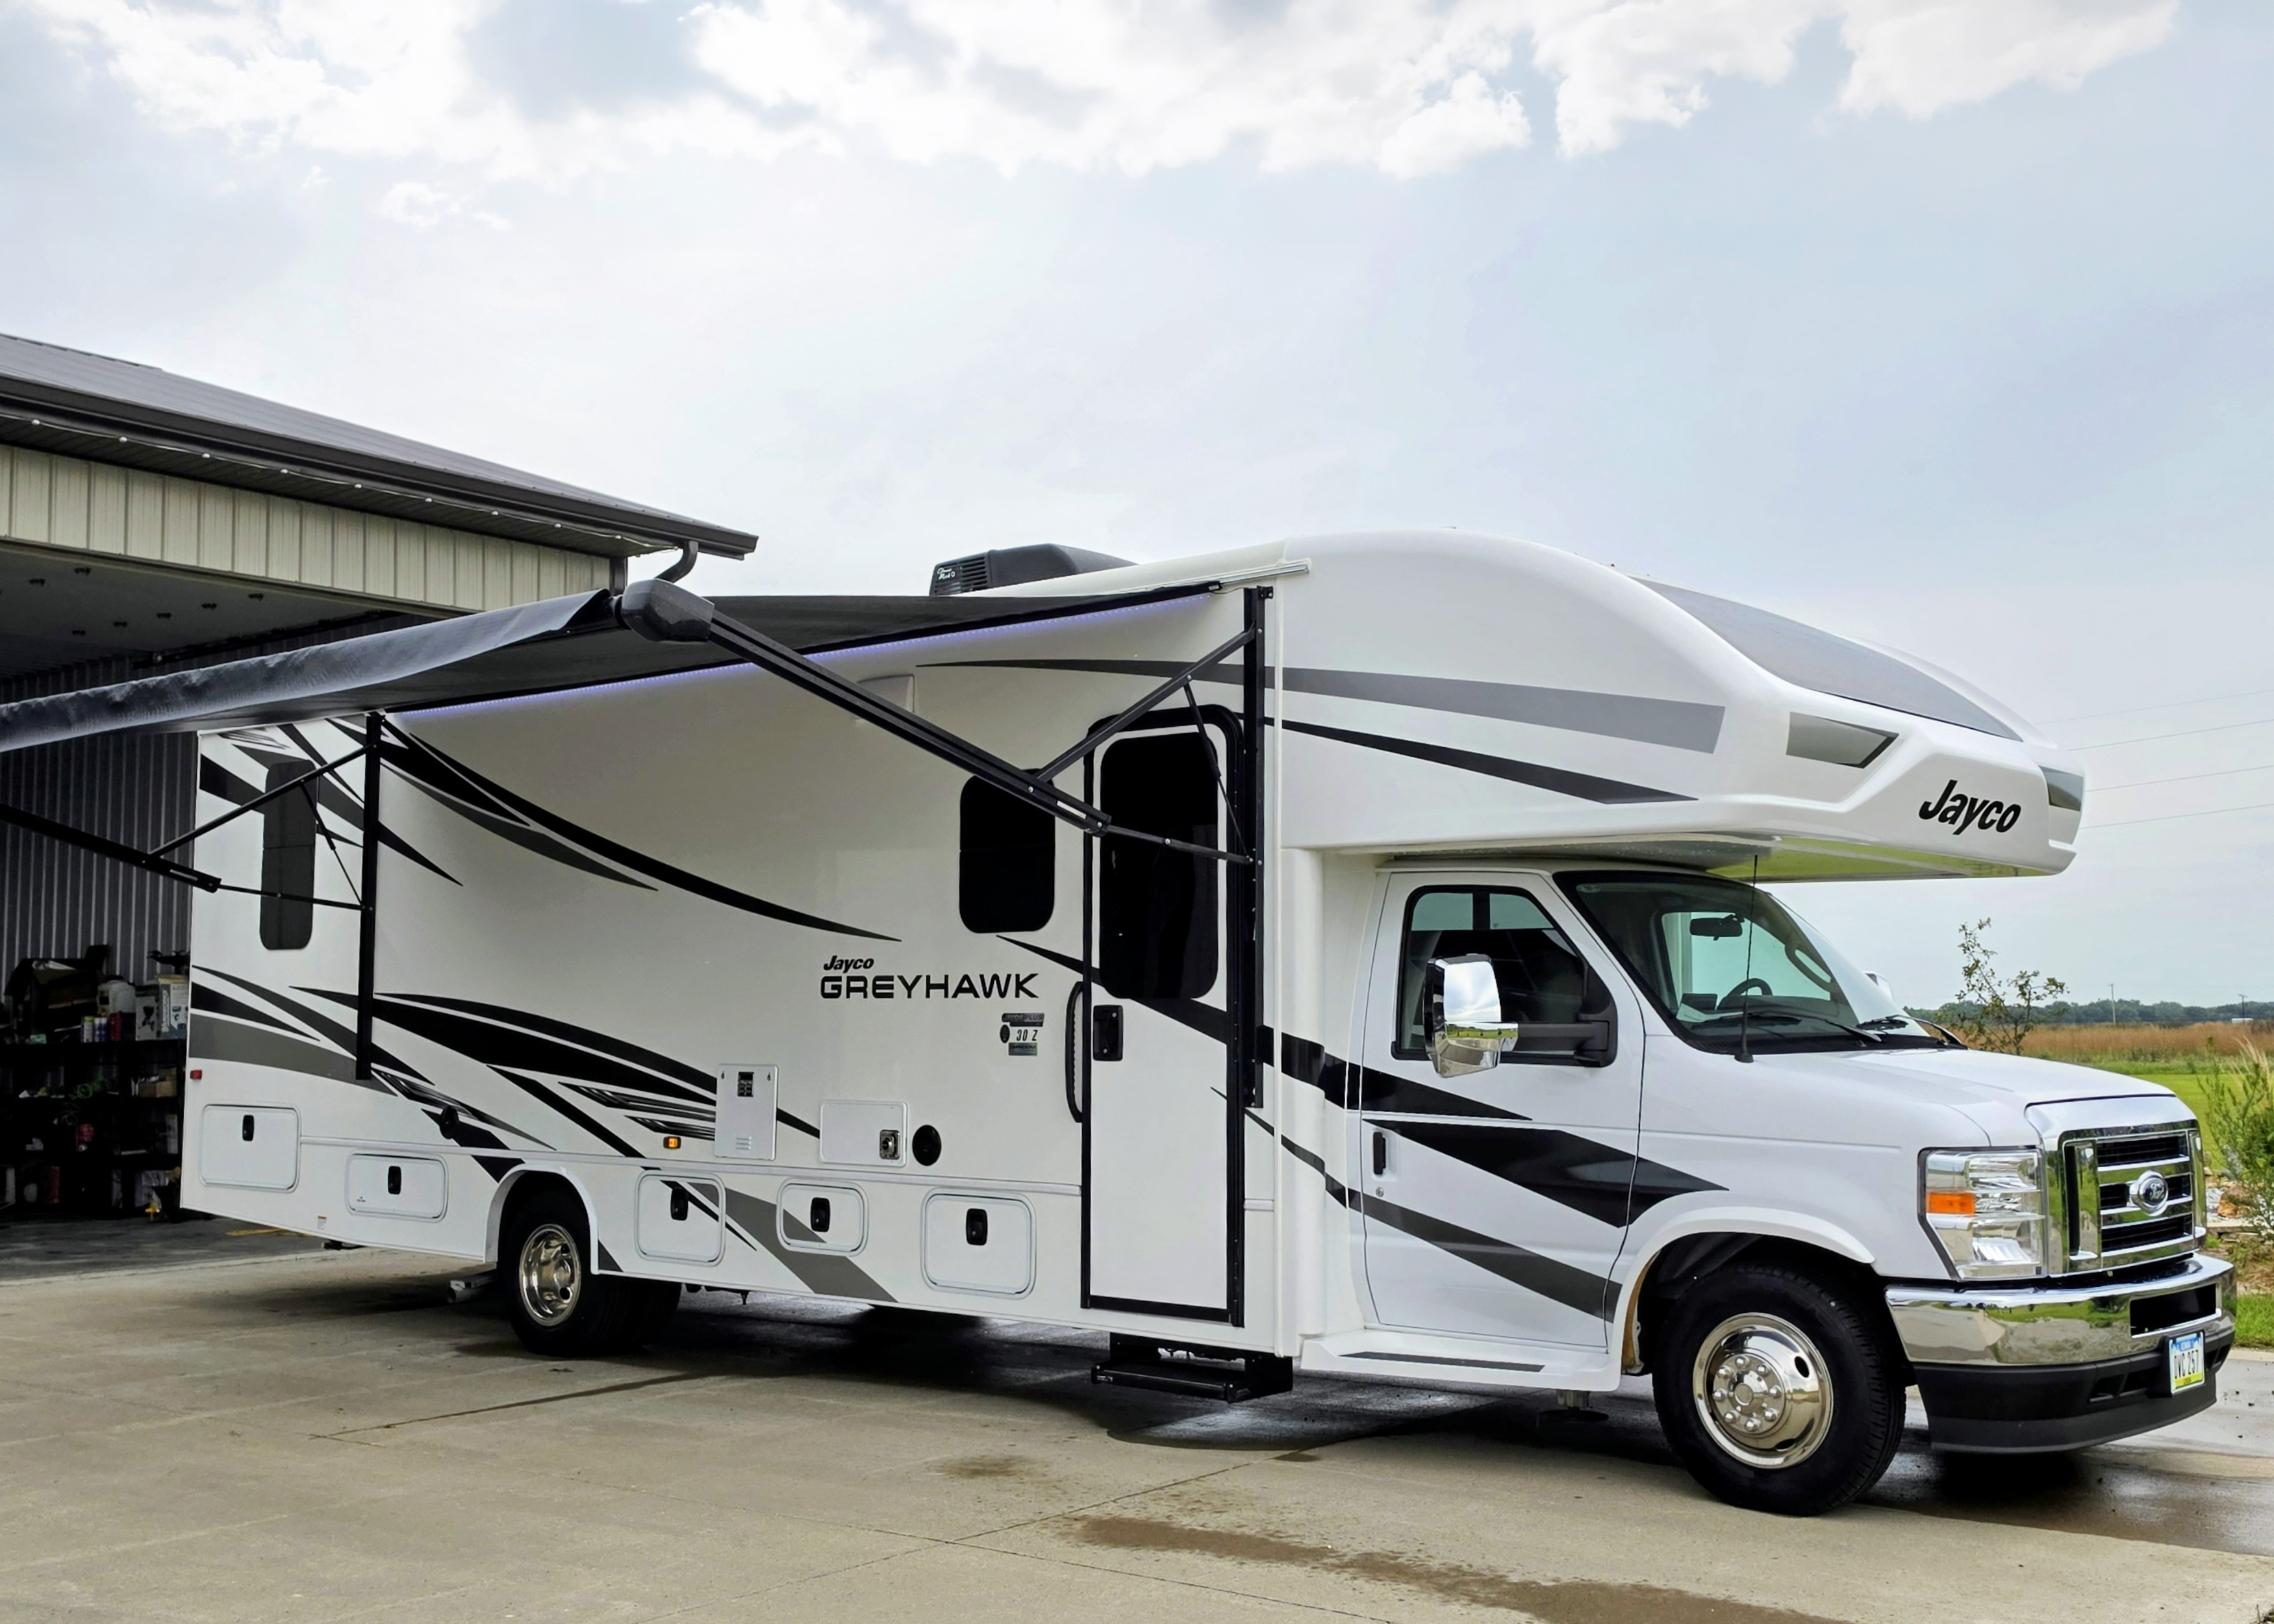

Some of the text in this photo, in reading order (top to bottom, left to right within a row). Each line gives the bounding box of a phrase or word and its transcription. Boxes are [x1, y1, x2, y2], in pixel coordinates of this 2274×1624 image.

[1919, 780, 2021, 835] Jayco
[823, 955, 874, 973] Jayco
[820, 973, 1039, 998] GREYHAWK
[1017, 1029, 1028, 1041] 30
